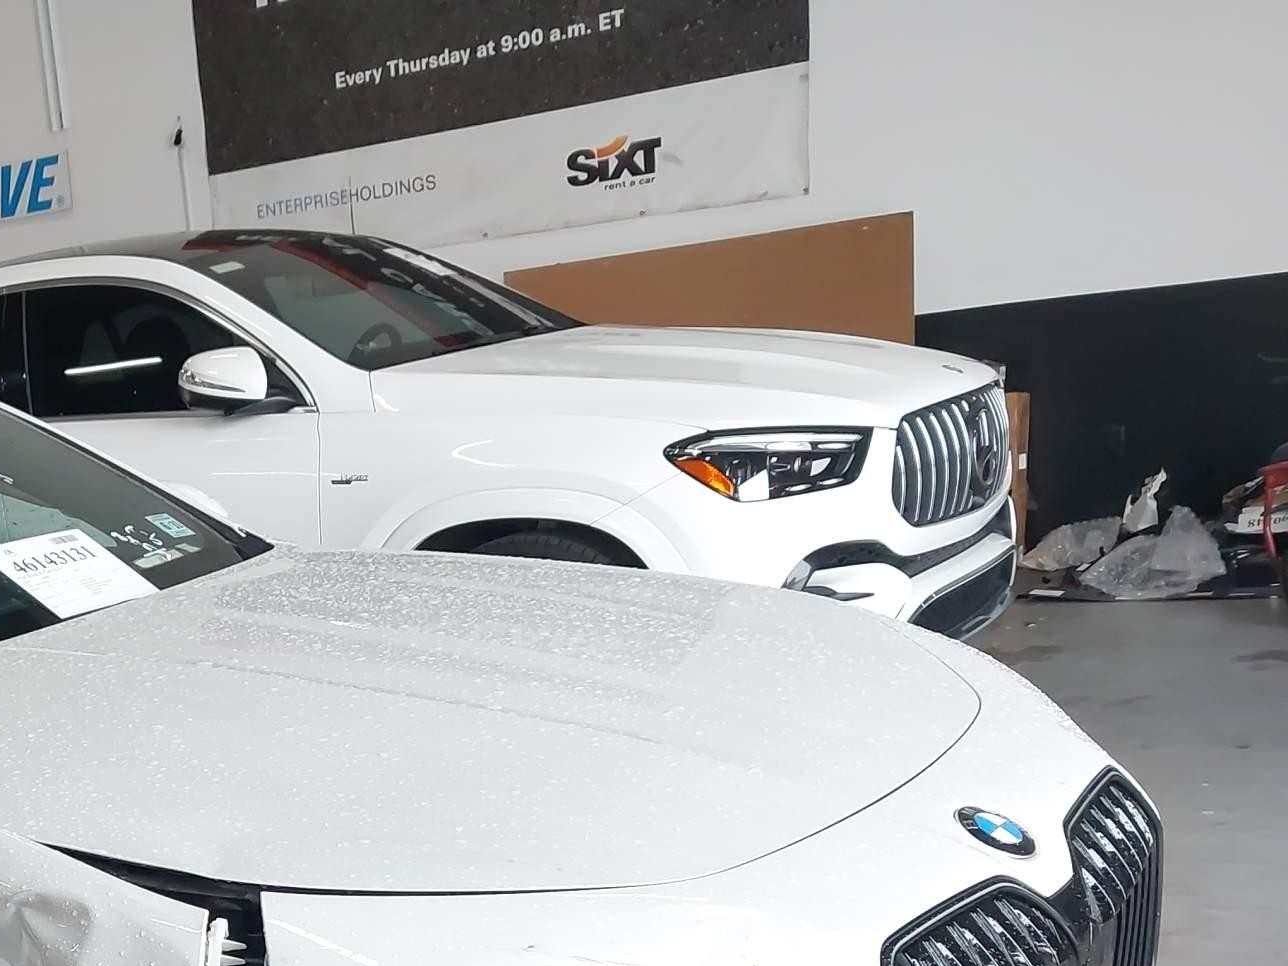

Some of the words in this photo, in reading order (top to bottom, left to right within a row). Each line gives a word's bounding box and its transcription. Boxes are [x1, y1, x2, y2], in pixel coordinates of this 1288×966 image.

[335, 66, 382, 89] Every
[387, 46, 471, 78] Thursday
[476, 39, 496, 58] at
[500, 28, 543, 52] 9:00
[549, 20, 592, 42] a.m.
[598, 9, 625, 31] ET
[604, 181, 626, 191] rent
[639, 176, 656, 186] car
[13, 545, 97, 574] 46143131
